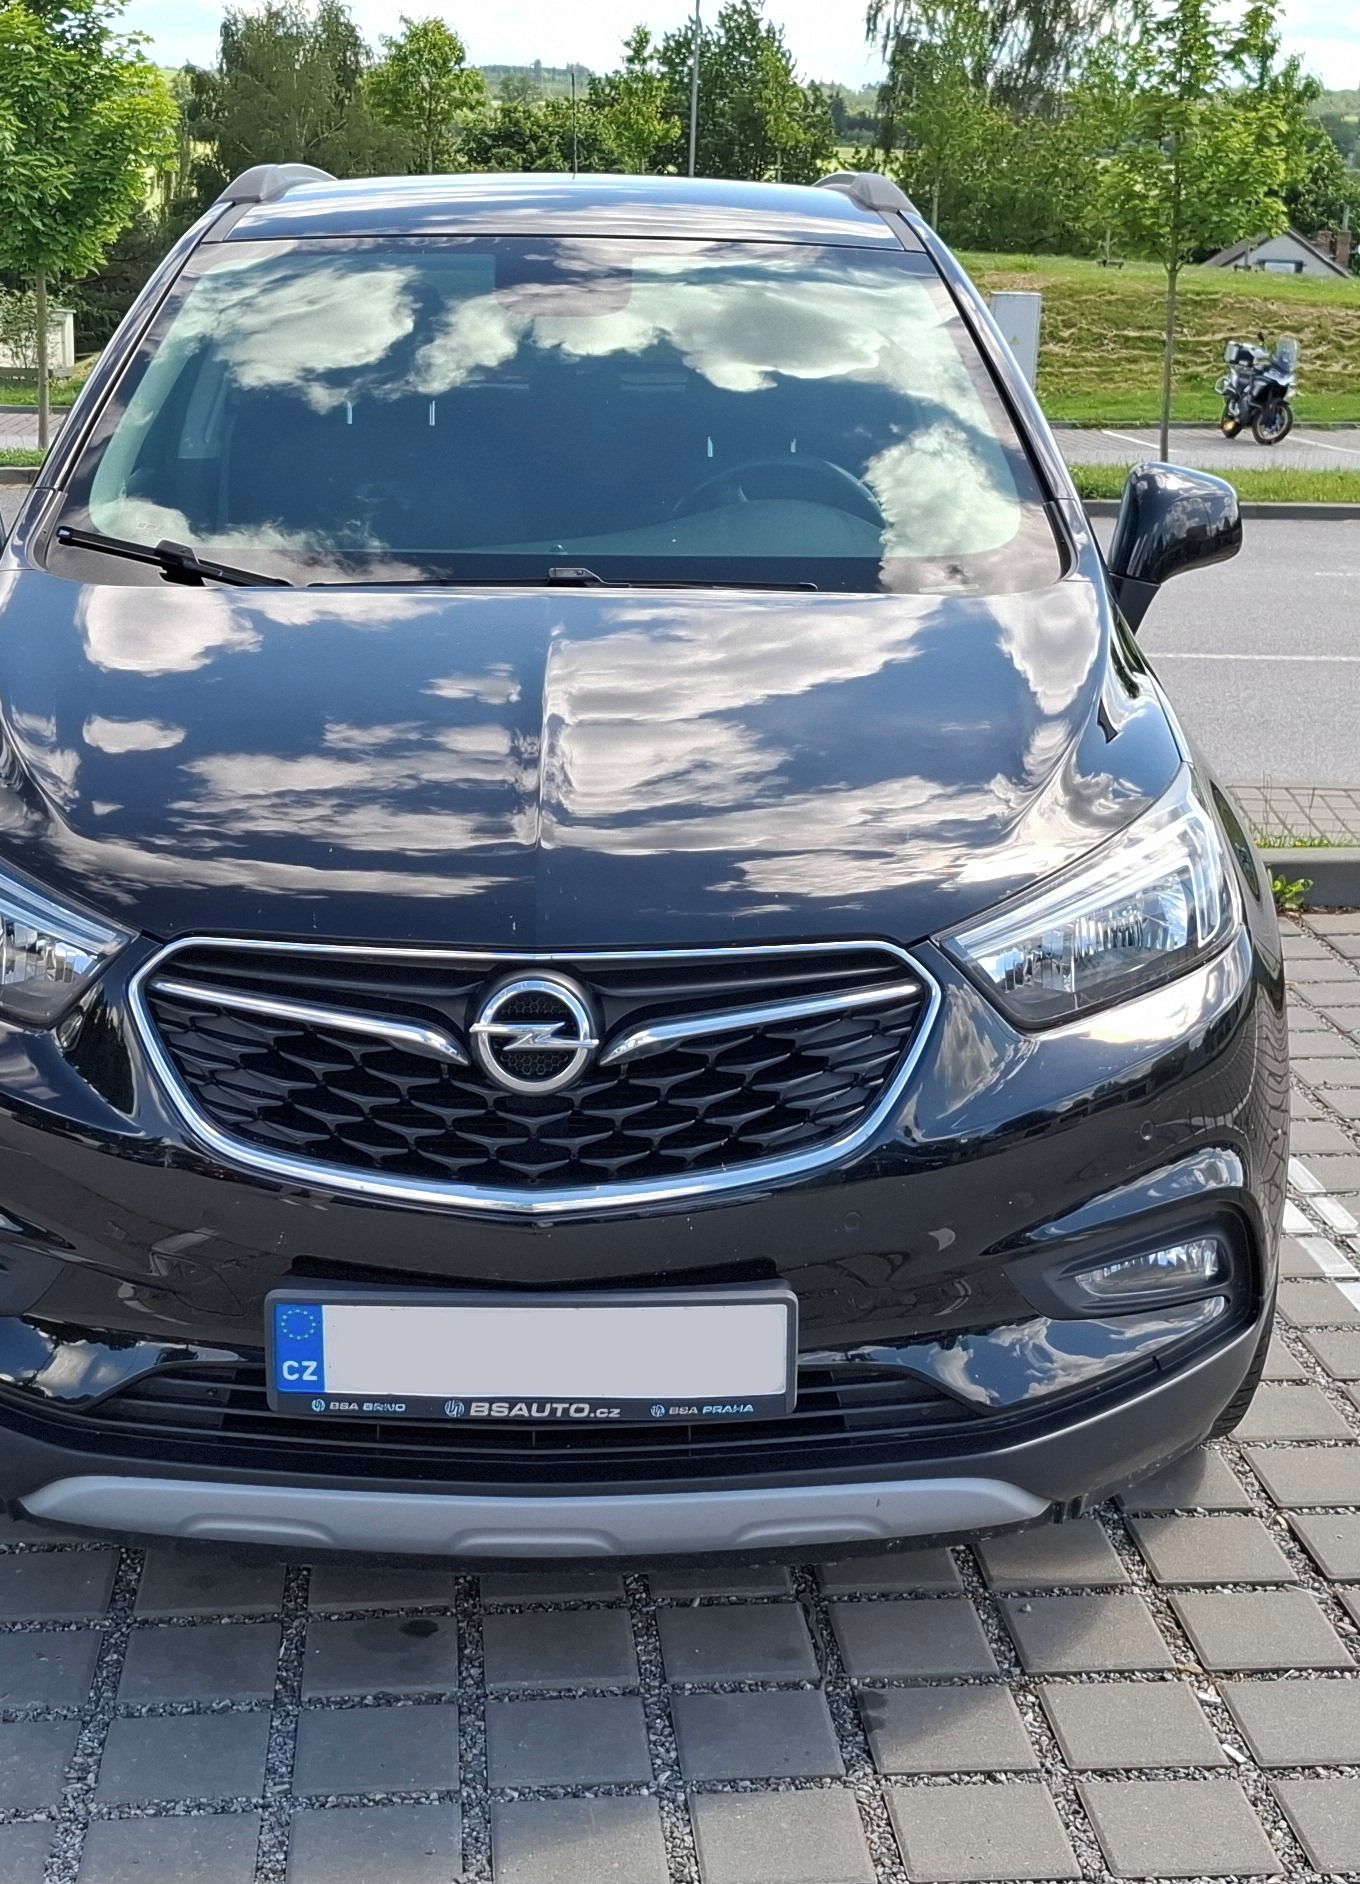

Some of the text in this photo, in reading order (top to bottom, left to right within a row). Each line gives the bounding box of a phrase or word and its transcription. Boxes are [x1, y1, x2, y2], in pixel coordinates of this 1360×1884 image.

[282, 1360, 318, 1381] CZ
[363, 1402, 406, 1412] BRNO
[469, 1402, 621, 1418] BSAUTO.cz
[702, 1404, 754, 1414] PRAHA
